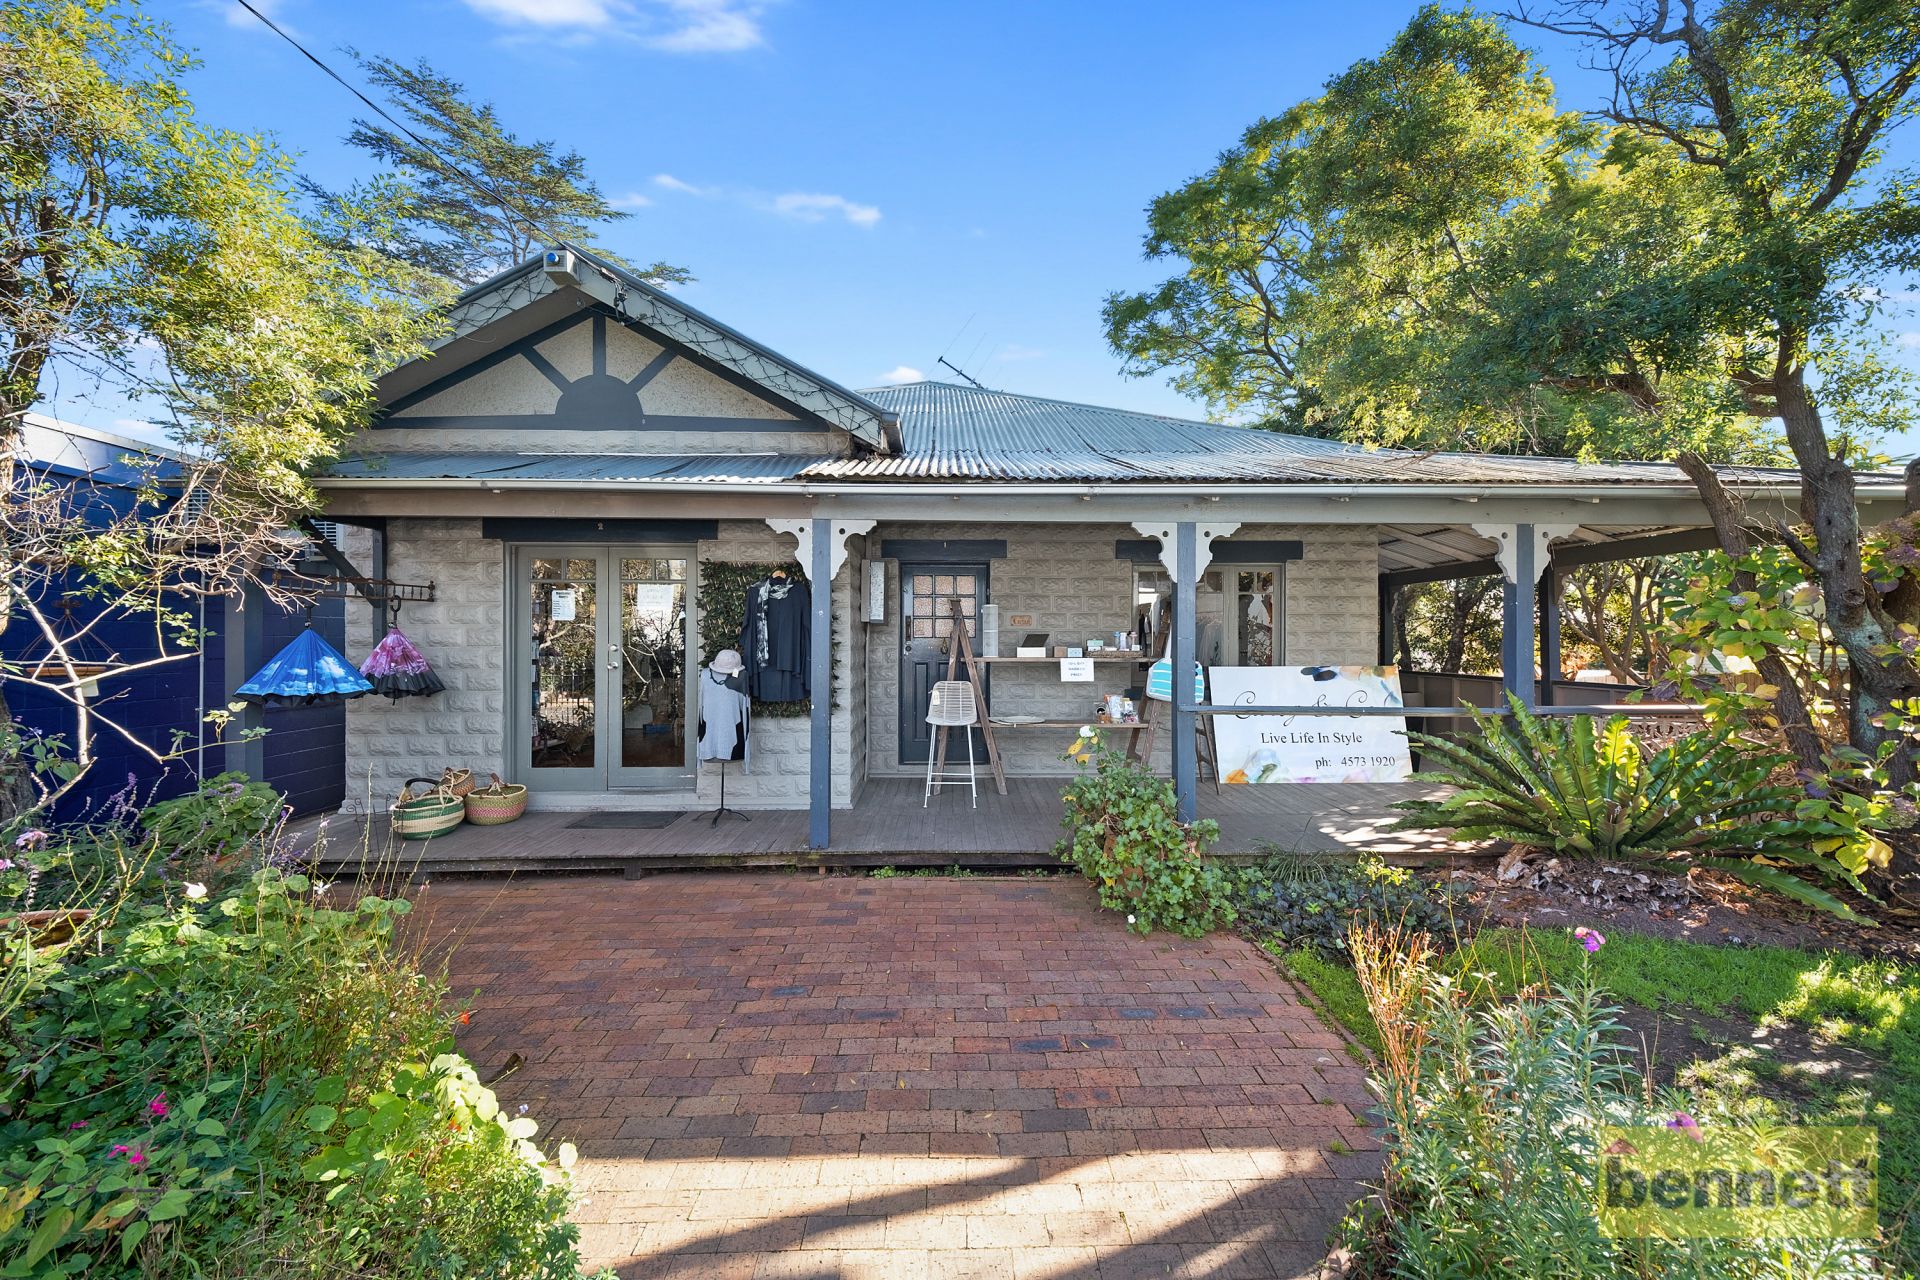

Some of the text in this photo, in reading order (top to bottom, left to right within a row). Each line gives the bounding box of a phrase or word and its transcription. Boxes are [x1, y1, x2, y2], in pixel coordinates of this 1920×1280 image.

[1261, 732, 1363, 746] Live Life In Style
[1315, 756, 1396, 769] ph: 4573 1920
